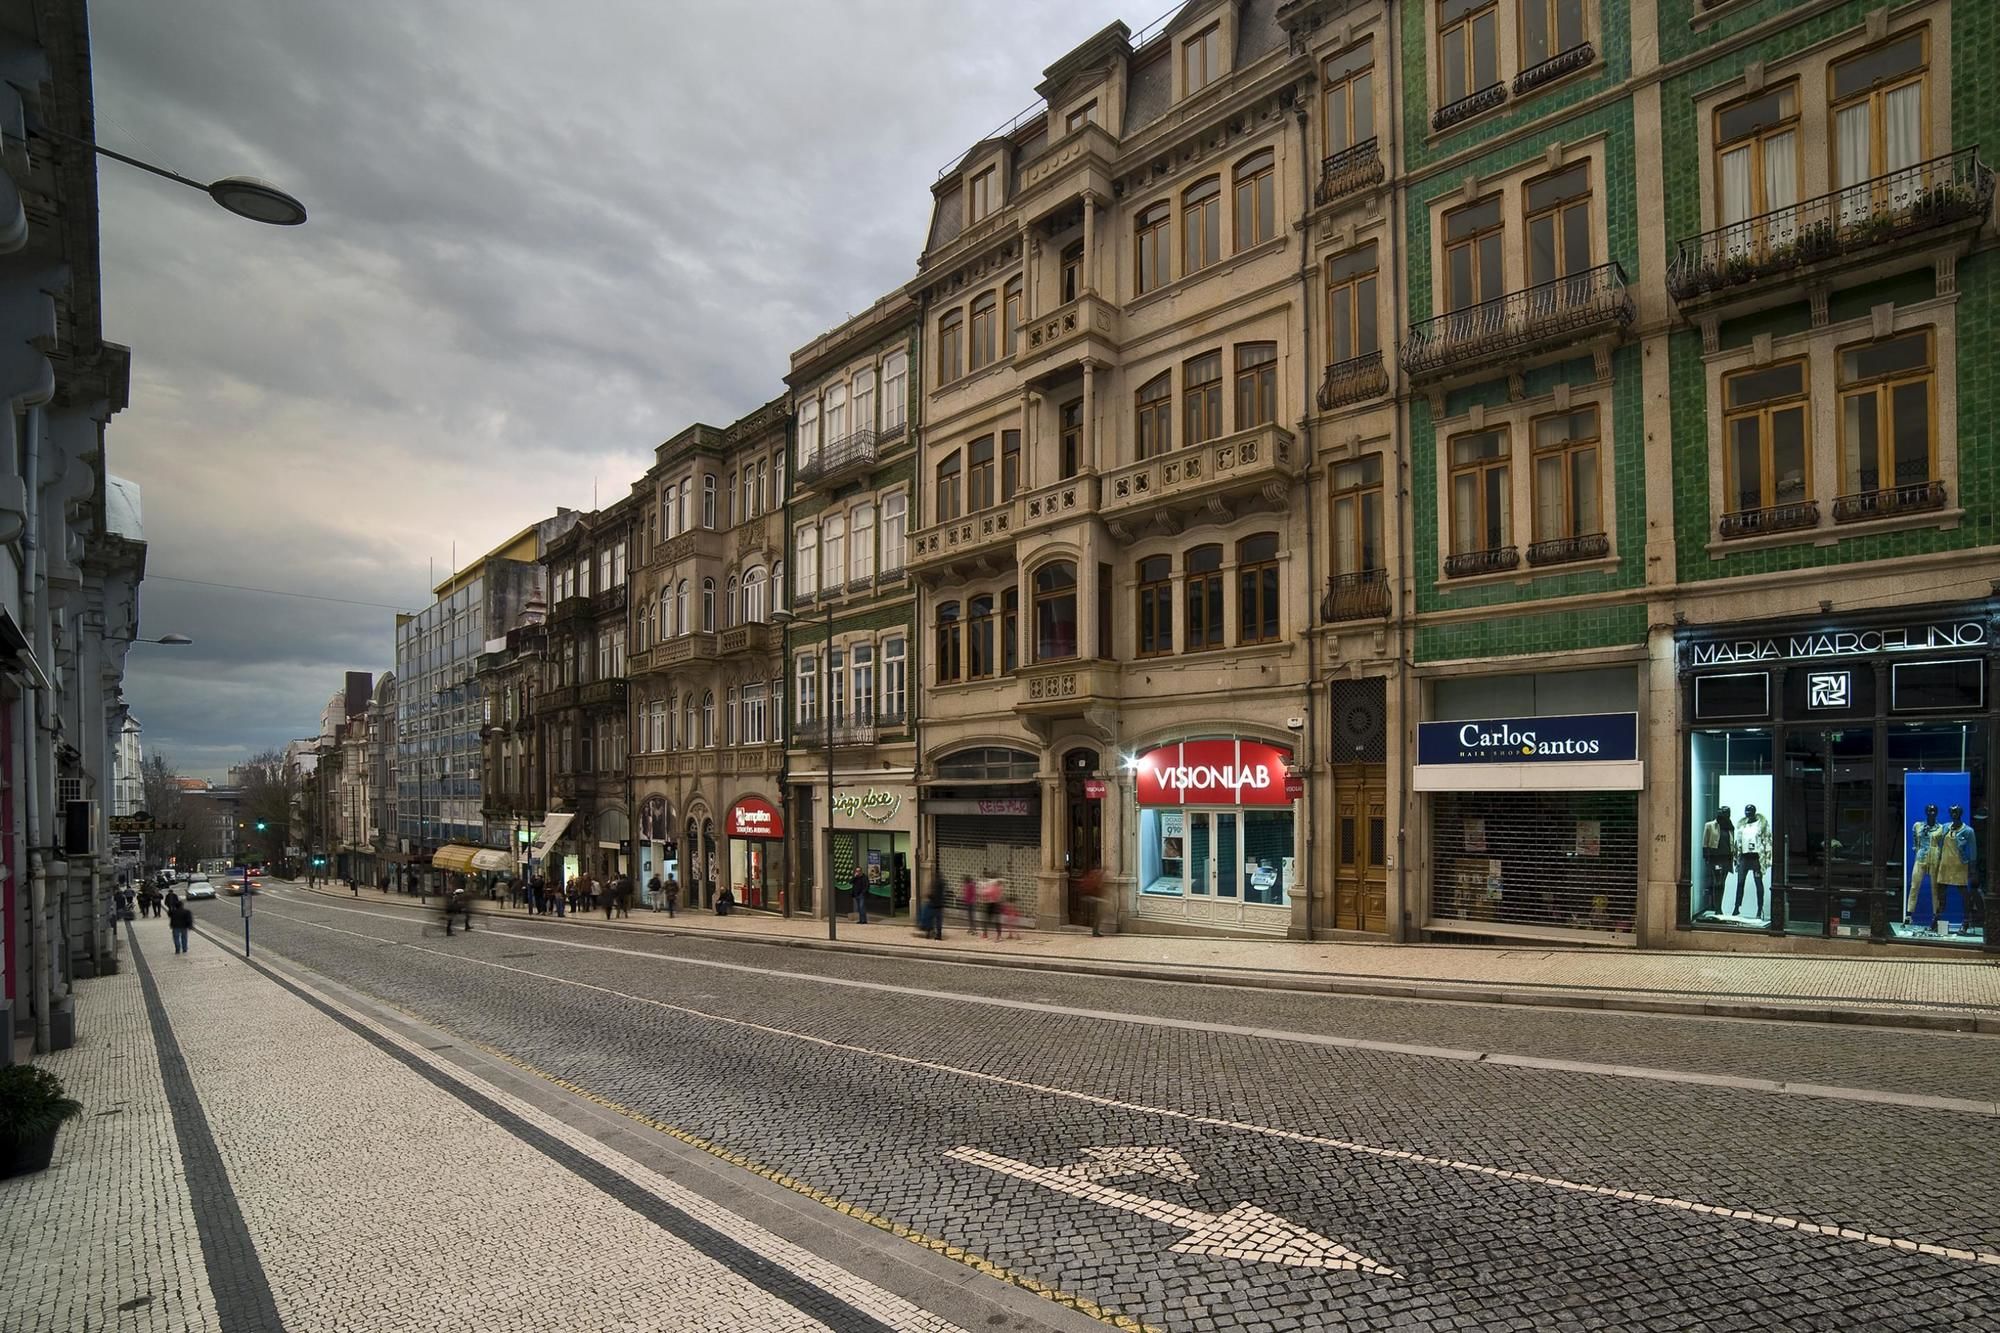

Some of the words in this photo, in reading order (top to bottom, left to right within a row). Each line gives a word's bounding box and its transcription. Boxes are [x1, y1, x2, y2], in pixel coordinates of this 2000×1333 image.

[1694, 639, 1782, 665] MARIA
[1790, 622, 1984, 656] MARCELINO
[1459, 750, 1486, 758] HAIR
[1521, 731, 1600, 756] Santos
[1153, 764, 1271, 791] VISIONLAB
[862, 787, 894, 809] doce
